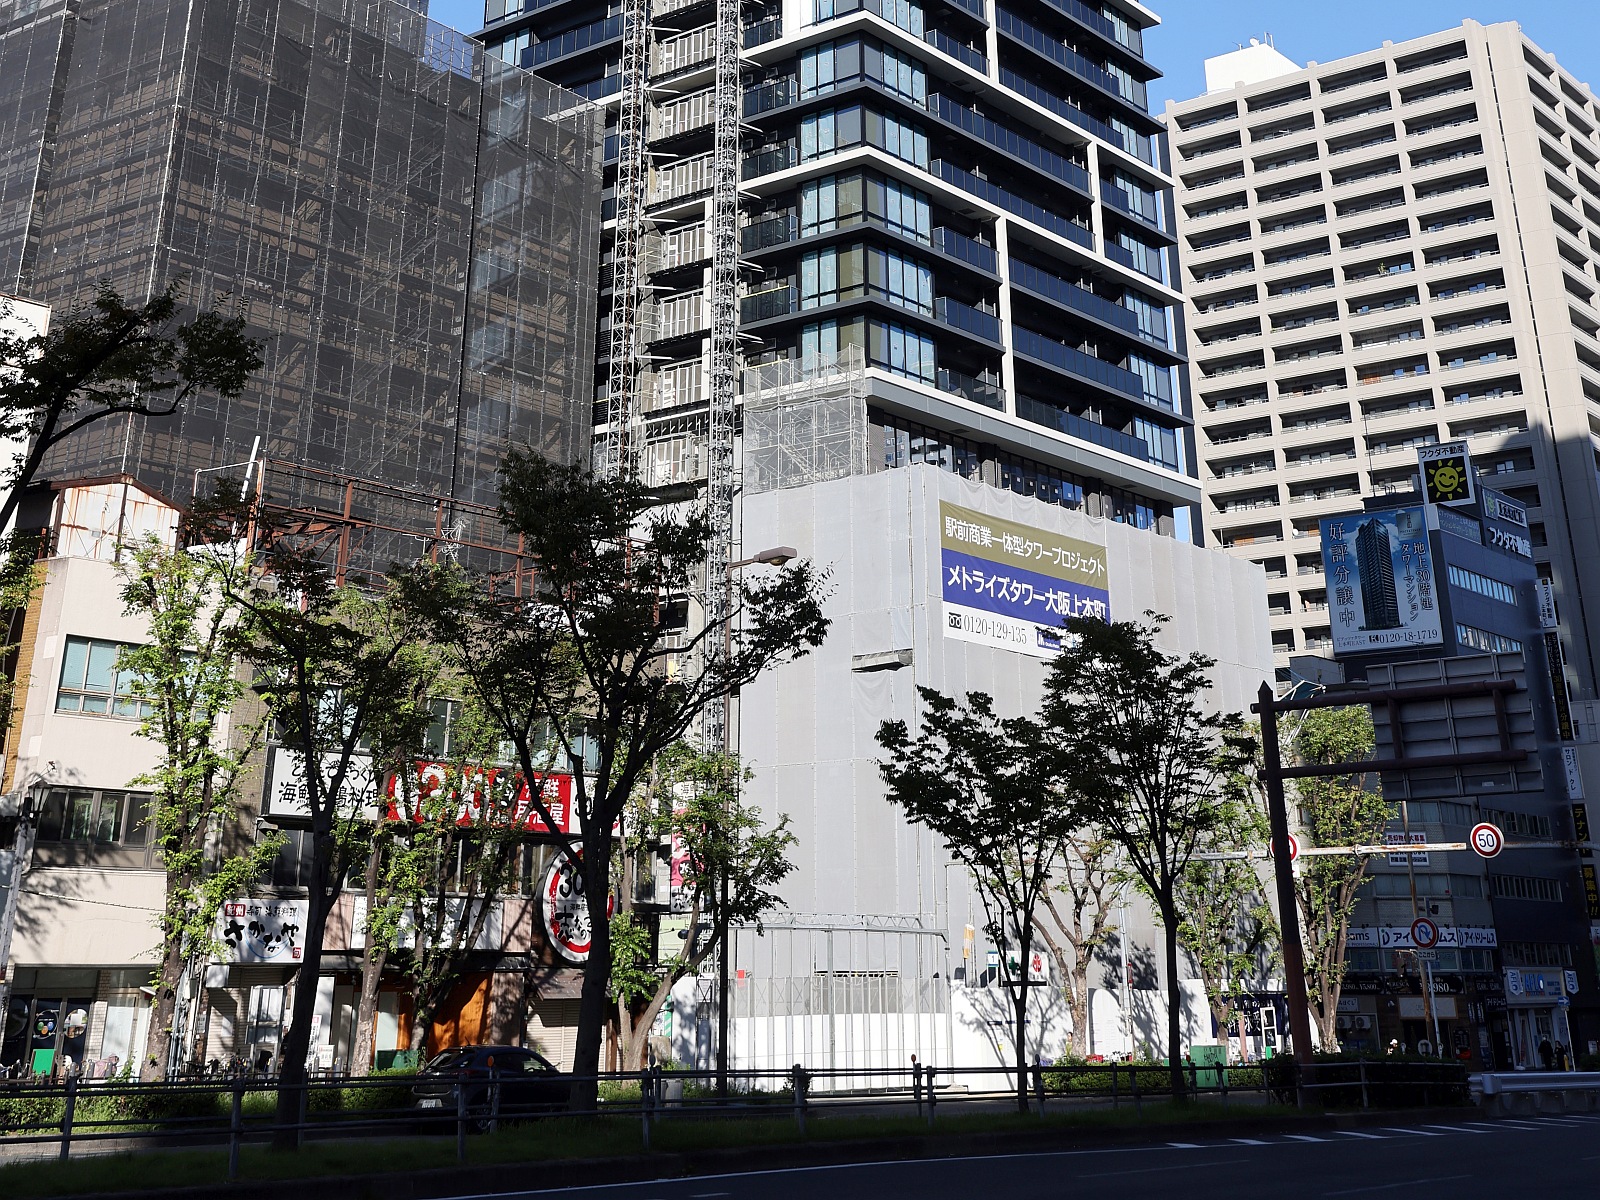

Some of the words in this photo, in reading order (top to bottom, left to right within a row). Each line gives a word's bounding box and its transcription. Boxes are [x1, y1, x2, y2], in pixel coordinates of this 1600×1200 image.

[1420, 444, 1465, 459] フクダ不動産
[945, 516, 1105, 577] 駅前商業一体型タワープロジェクト
[1488, 526, 1533, 559] フクダ不動産
[1329, 522, 1355, 628] 好評分譲中
[1400, 543, 1419, 622] タワーマンション
[1412, 541, 1434, 611] 地上30階建
[947, 565, 1107, 619] メトライズタワー大阪上本町
[963, 614, 1027, 644] 0120-129-135
[1379, 628, 1438, 644] 0120-18-1719
[1477, 833, 1495, 848] 50
[224, 919, 299, 953] さかなや
[1418, 951, 1436, 959] ここから
